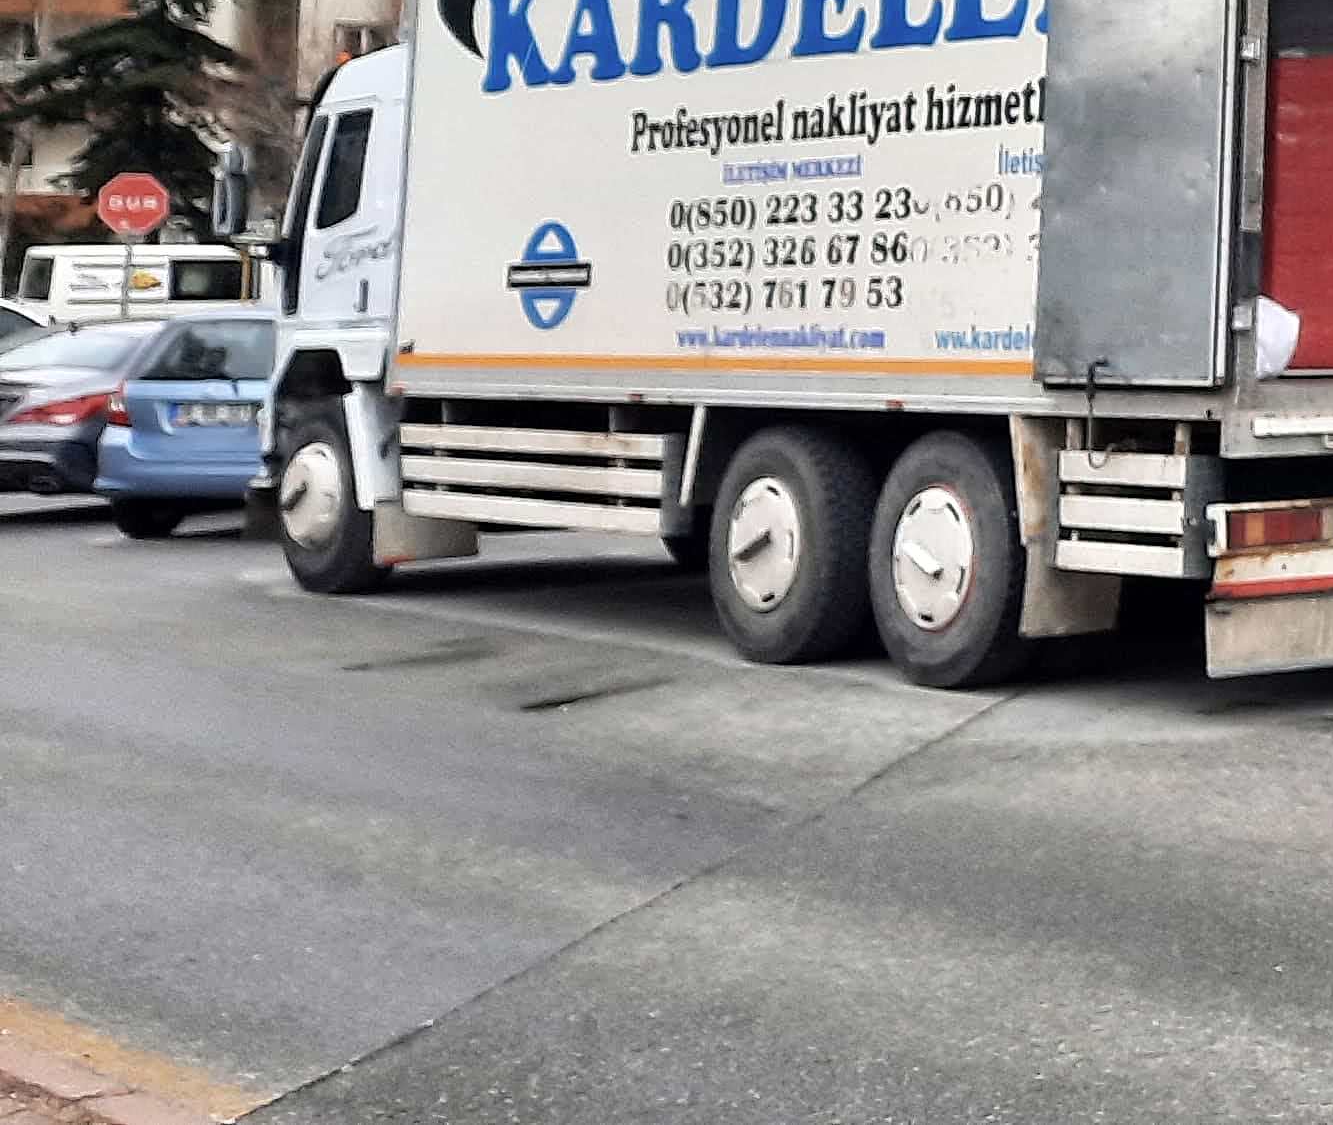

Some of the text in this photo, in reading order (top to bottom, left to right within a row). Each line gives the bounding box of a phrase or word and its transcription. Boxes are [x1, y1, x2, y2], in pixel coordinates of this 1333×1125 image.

[631, 76, 1048, 156] Profesyonel nakliyat hizmetl
[670, 187, 912, 234] 0(850) 223 33 23
[667, 238, 754, 275] 0(352)
[762, 235, 816, 268] 326
[827, 233, 861, 265] 67
[869, 230, 909, 265] 86
[666, 274, 904, 315] 0(532) 761 79 53
